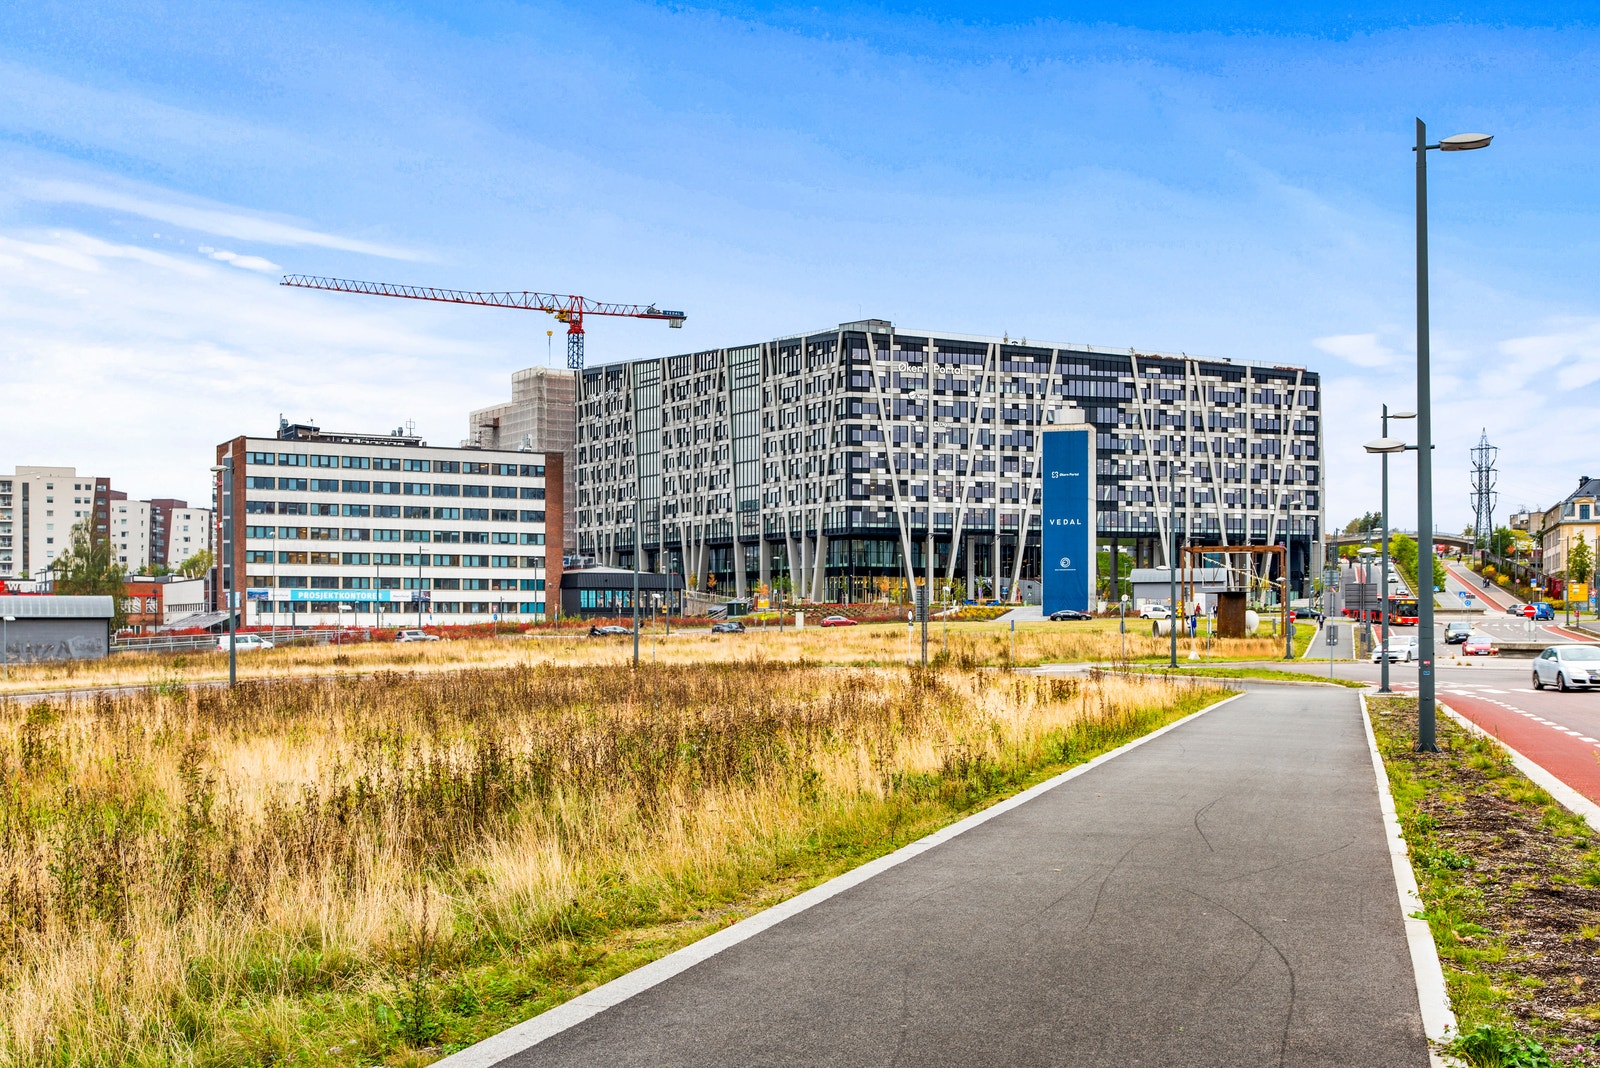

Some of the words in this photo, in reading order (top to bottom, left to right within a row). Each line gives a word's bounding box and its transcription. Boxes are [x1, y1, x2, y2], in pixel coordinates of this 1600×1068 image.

[898, 362, 928, 373] Økern
[933, 364, 963, 375] Portal
[298, 591, 383, 600] PROSJEKTKONTORER
